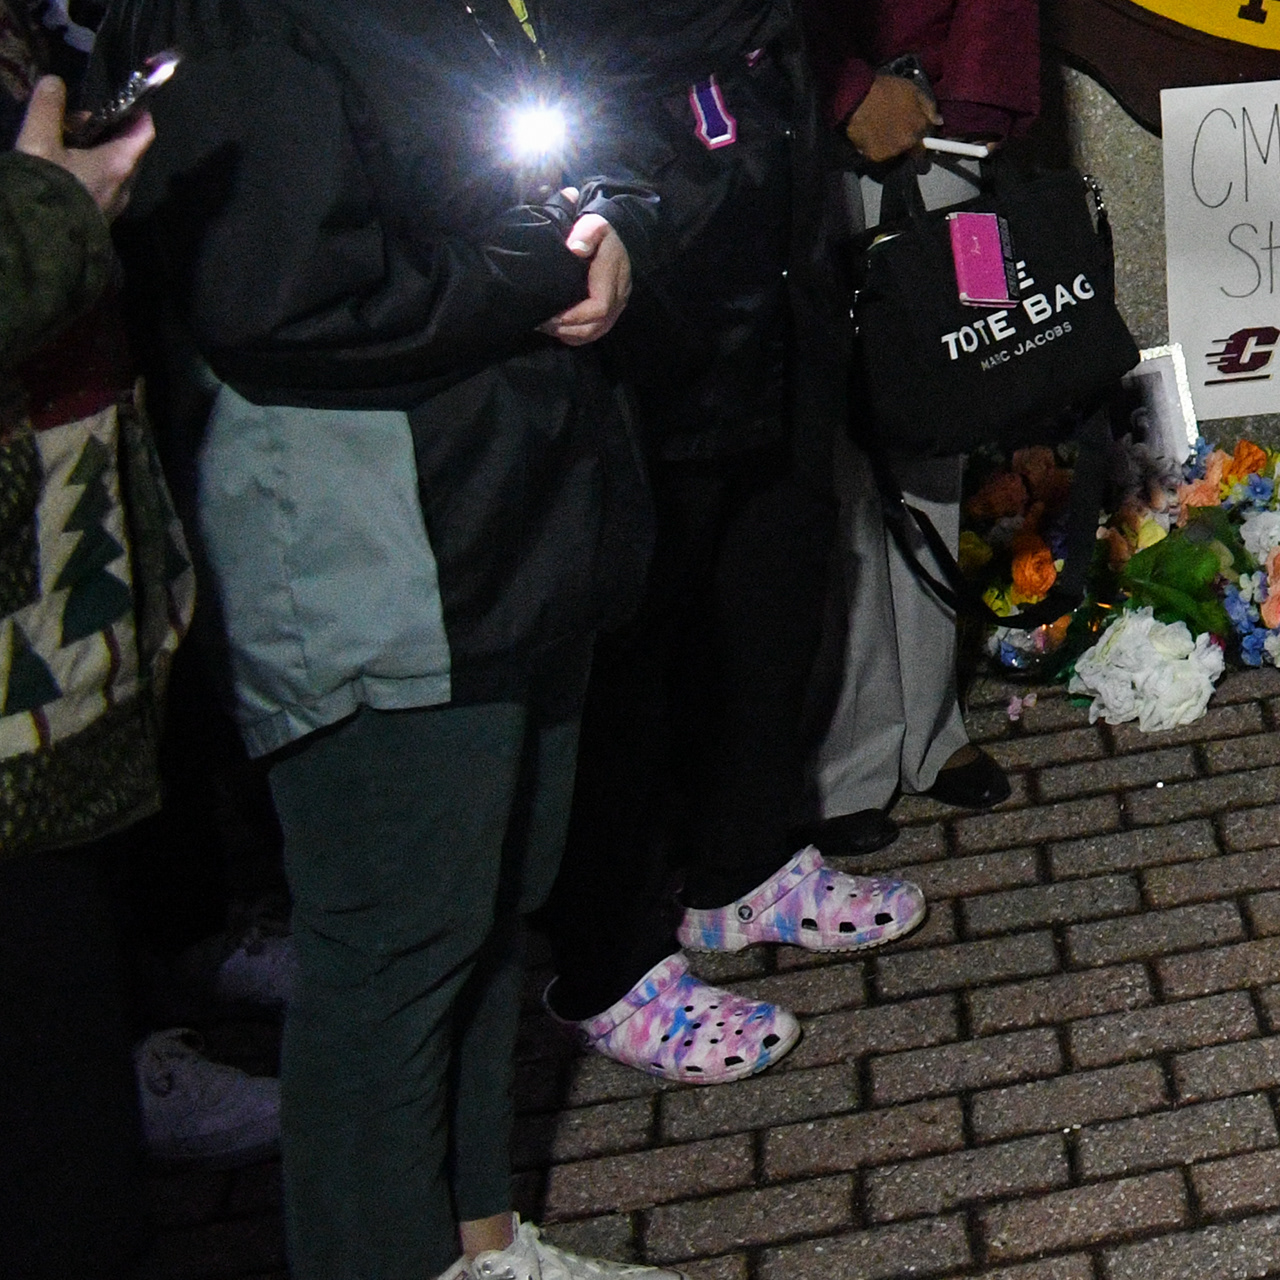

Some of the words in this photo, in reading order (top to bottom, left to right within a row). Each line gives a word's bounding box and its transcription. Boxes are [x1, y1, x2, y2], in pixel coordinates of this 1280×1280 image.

[941, 310, 1017, 361] TOTE
[1022, 273, 1096, 325] BAG
[1014, 321, 1073, 356] JACOBS
